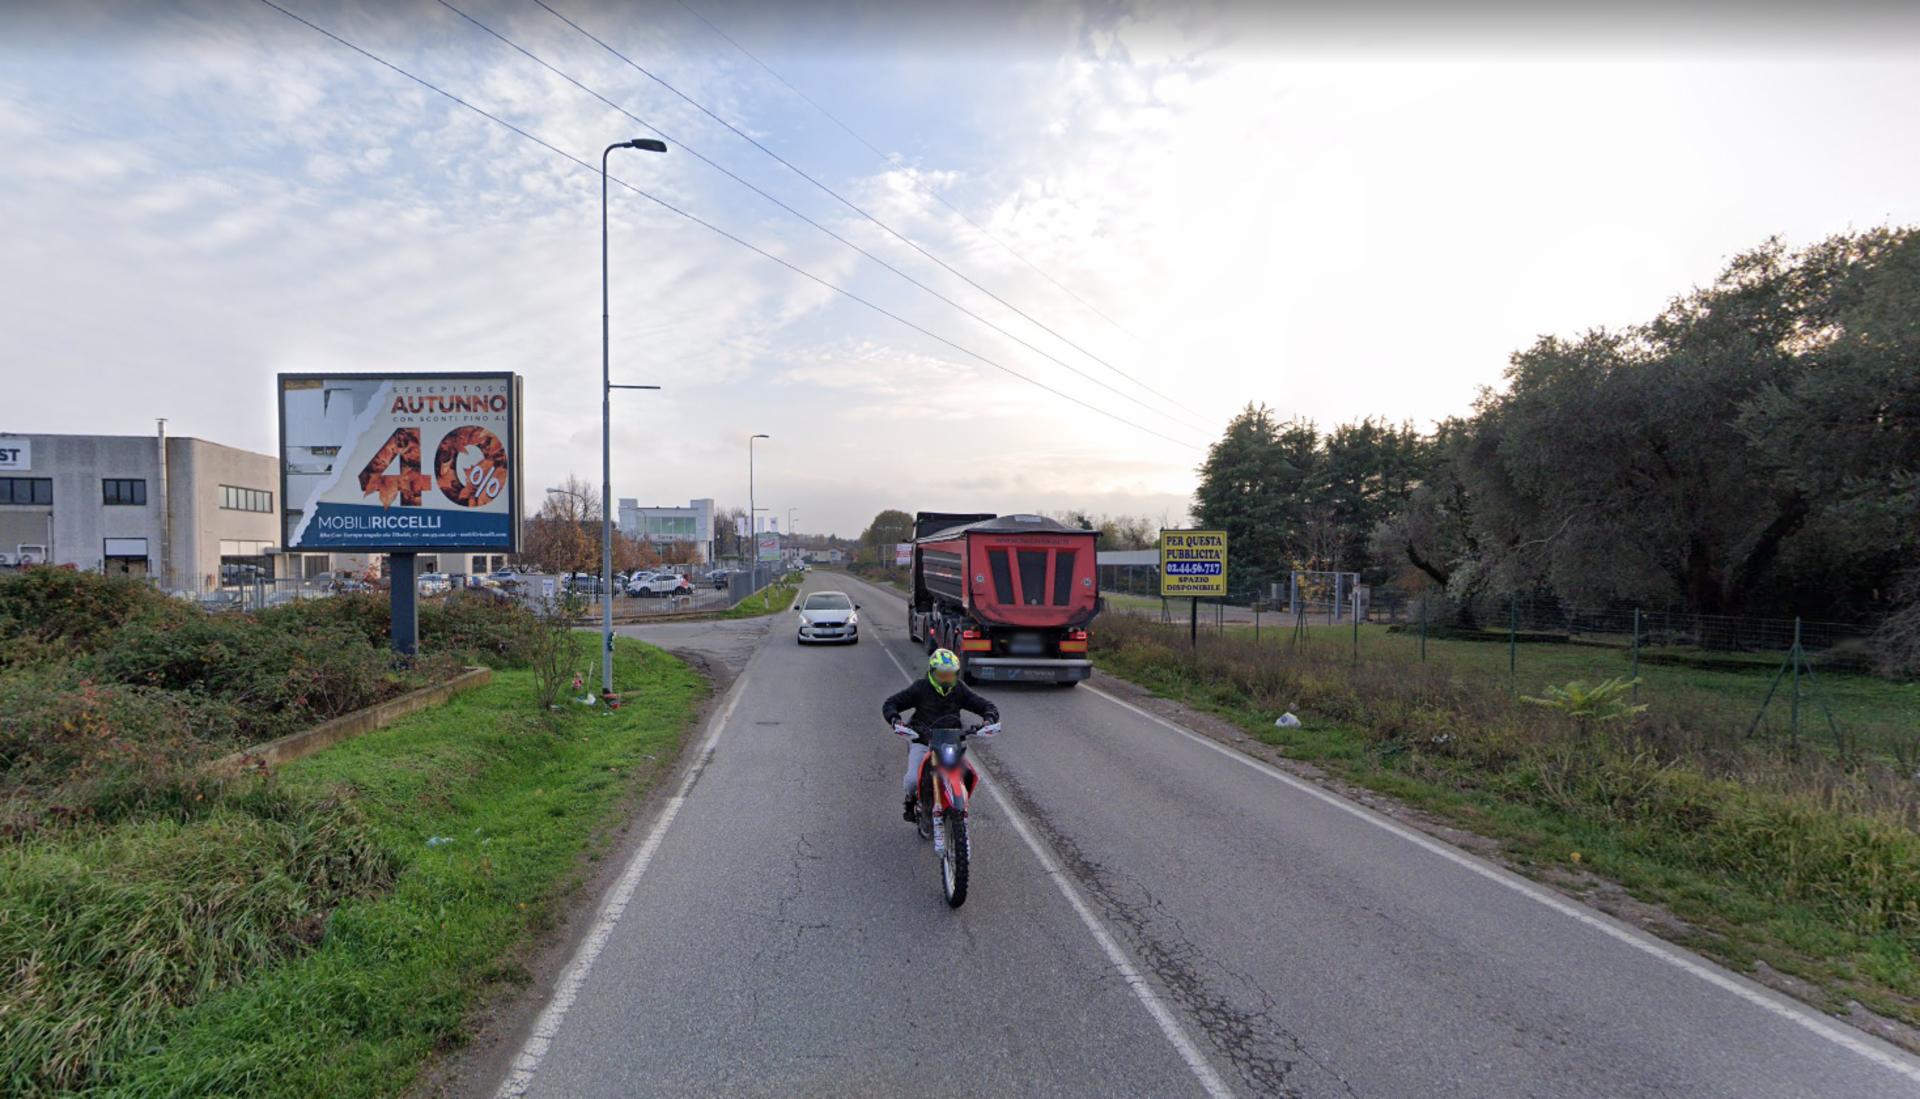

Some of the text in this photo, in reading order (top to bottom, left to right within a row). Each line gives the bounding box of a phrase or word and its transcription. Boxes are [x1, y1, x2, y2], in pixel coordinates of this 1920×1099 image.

[392, 385, 507, 393] STREPITOSO
[391, 394, 507, 414] AUTUNNO
[1167, 536, 1222, 547] PER QUESTA
[1167, 549, 1222, 559] PUBBLICITA'
[1167, 563, 1220, 574] 02.44.56.717
